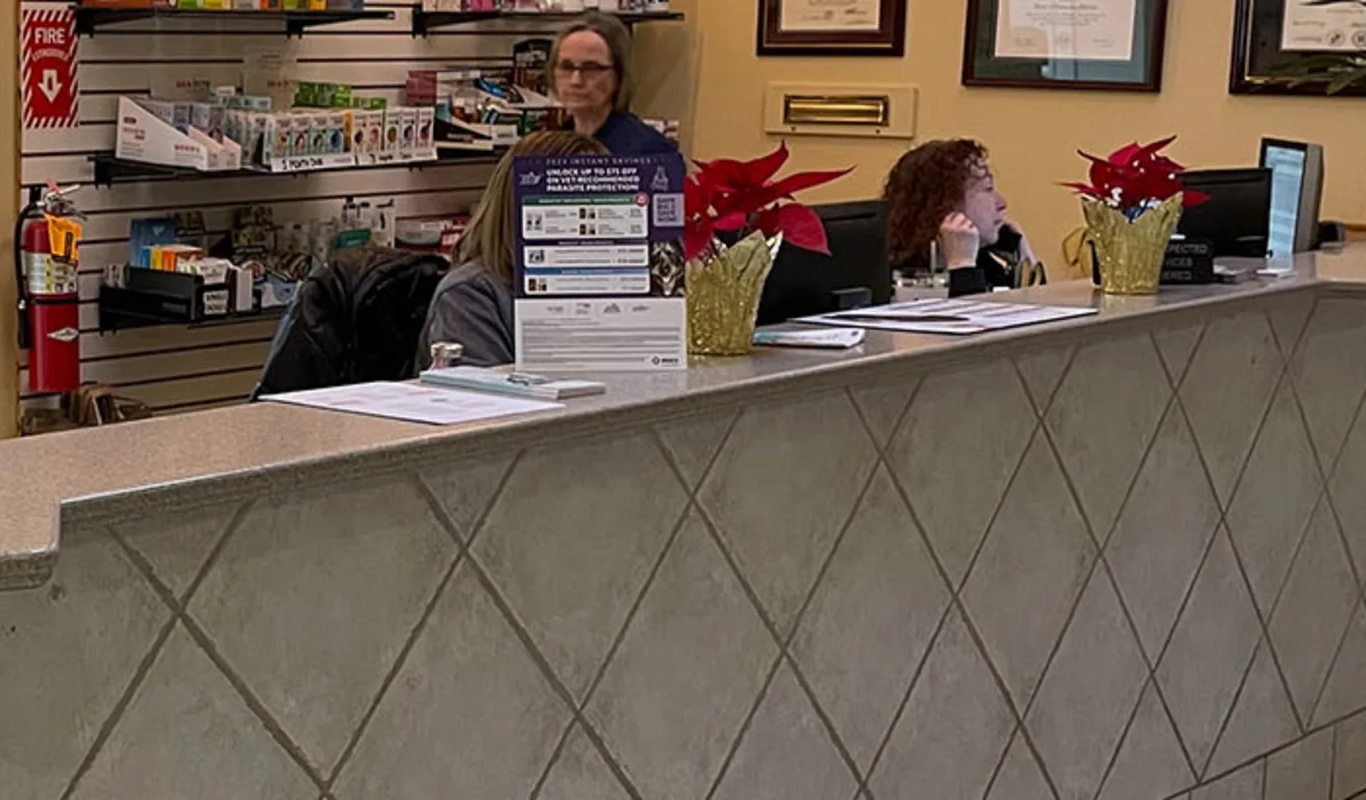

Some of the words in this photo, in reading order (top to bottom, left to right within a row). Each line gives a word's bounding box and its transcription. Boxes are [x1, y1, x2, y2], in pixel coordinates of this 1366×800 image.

[34, 27, 66, 44] FIRE
[570, 158, 610, 166] INSTANT
[612, 157, 651, 165] SAVINGS
[546, 168, 578, 176] UNLOCK
[594, 167, 605, 175] TO
[622, 167, 637, 175] OFF
[546, 184, 584, 192] PARASITE
